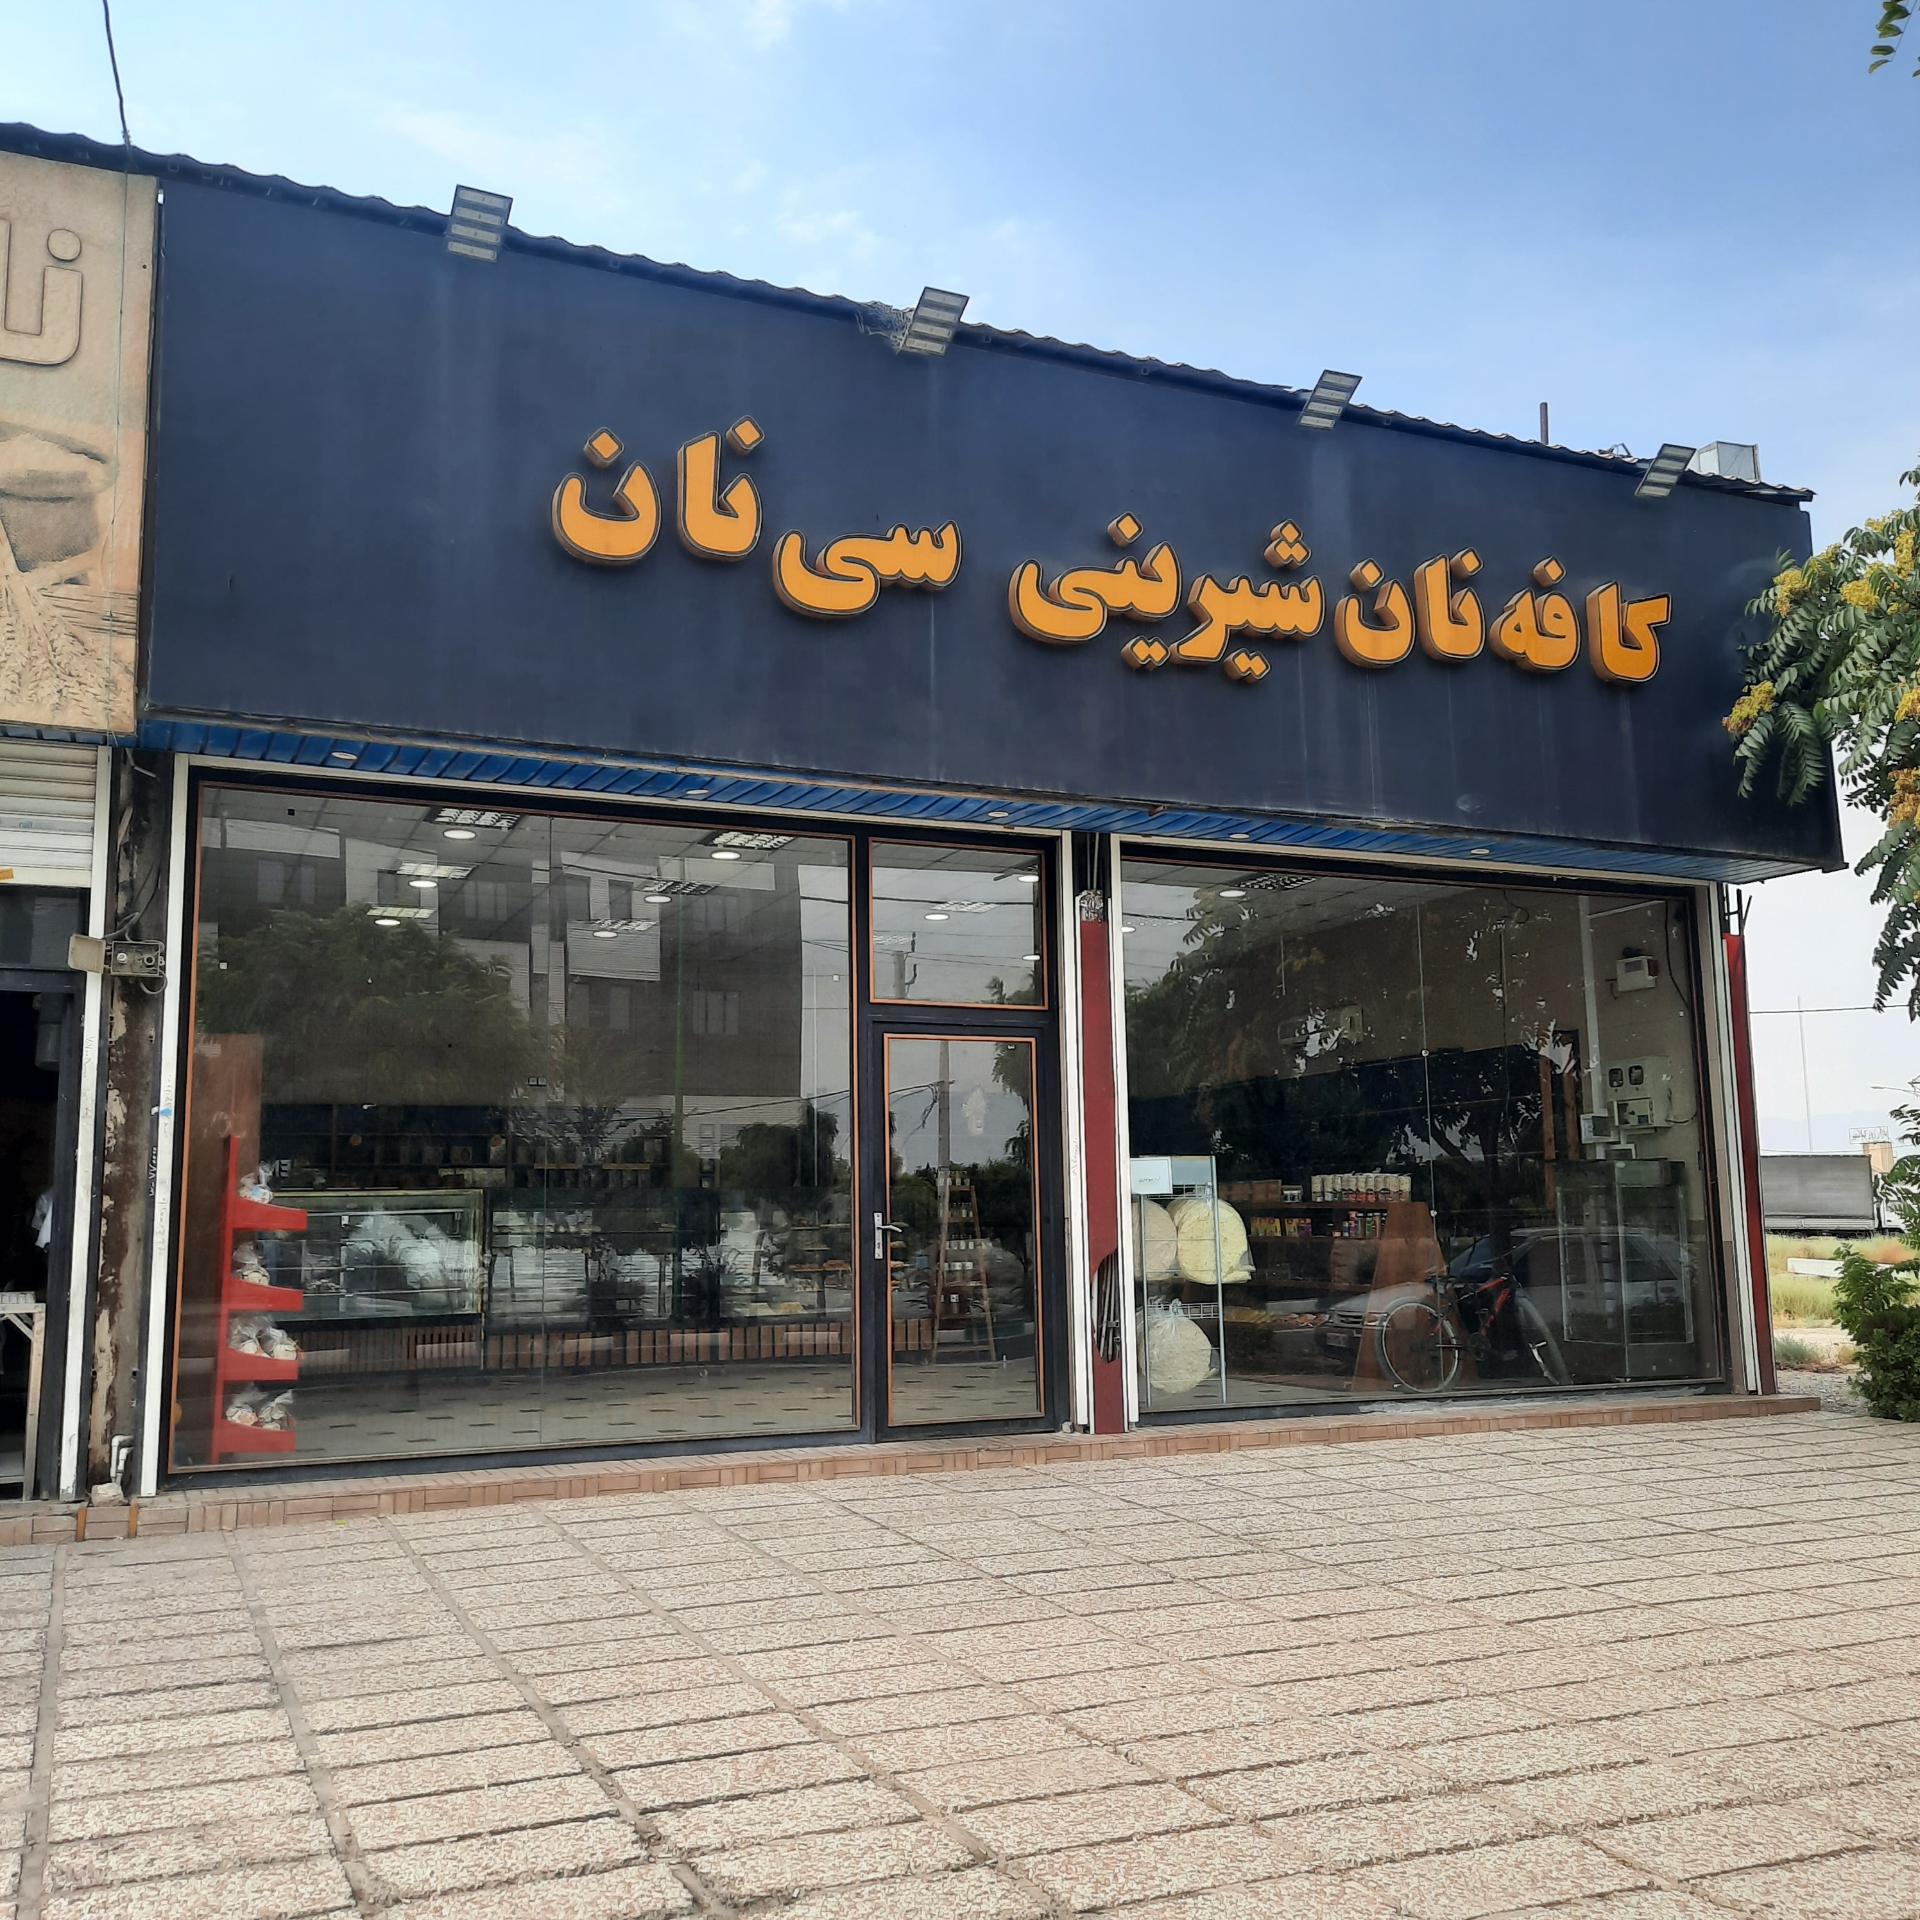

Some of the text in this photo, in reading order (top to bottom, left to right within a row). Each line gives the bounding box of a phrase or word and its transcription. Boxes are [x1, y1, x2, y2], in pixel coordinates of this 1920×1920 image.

[553, 415, 1671, 684] کافه نان شیرینی سی نان
